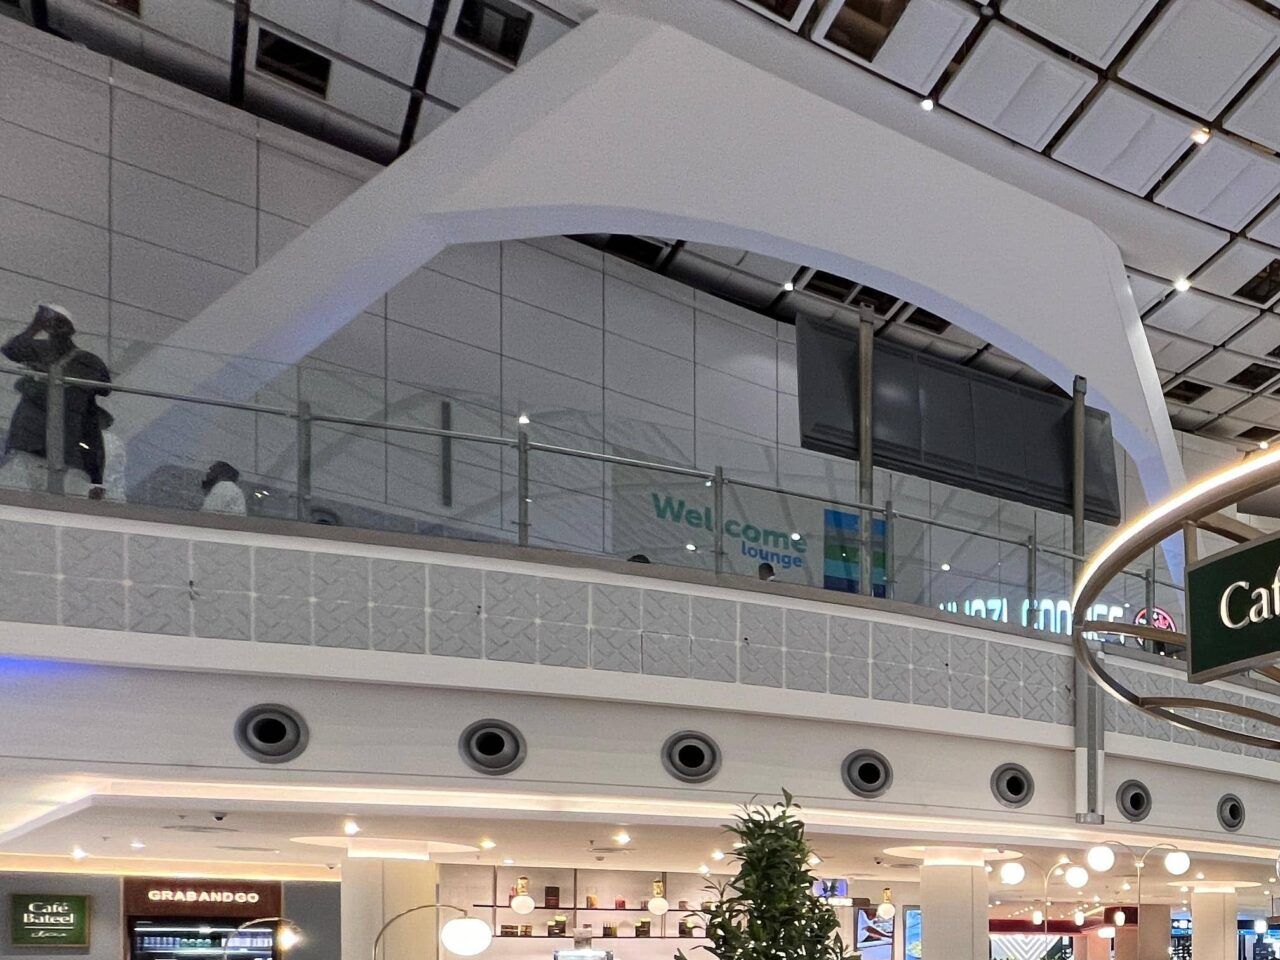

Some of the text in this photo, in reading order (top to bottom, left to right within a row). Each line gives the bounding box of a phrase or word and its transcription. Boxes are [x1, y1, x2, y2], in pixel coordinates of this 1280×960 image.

[652, 493, 807, 553] Welcome
[741, 541, 803, 569] lounge
[148, 890, 259, 903] GRAB AND GO
[28, 902, 69, 913] Café
[23, 913, 74, 924] Bateel
